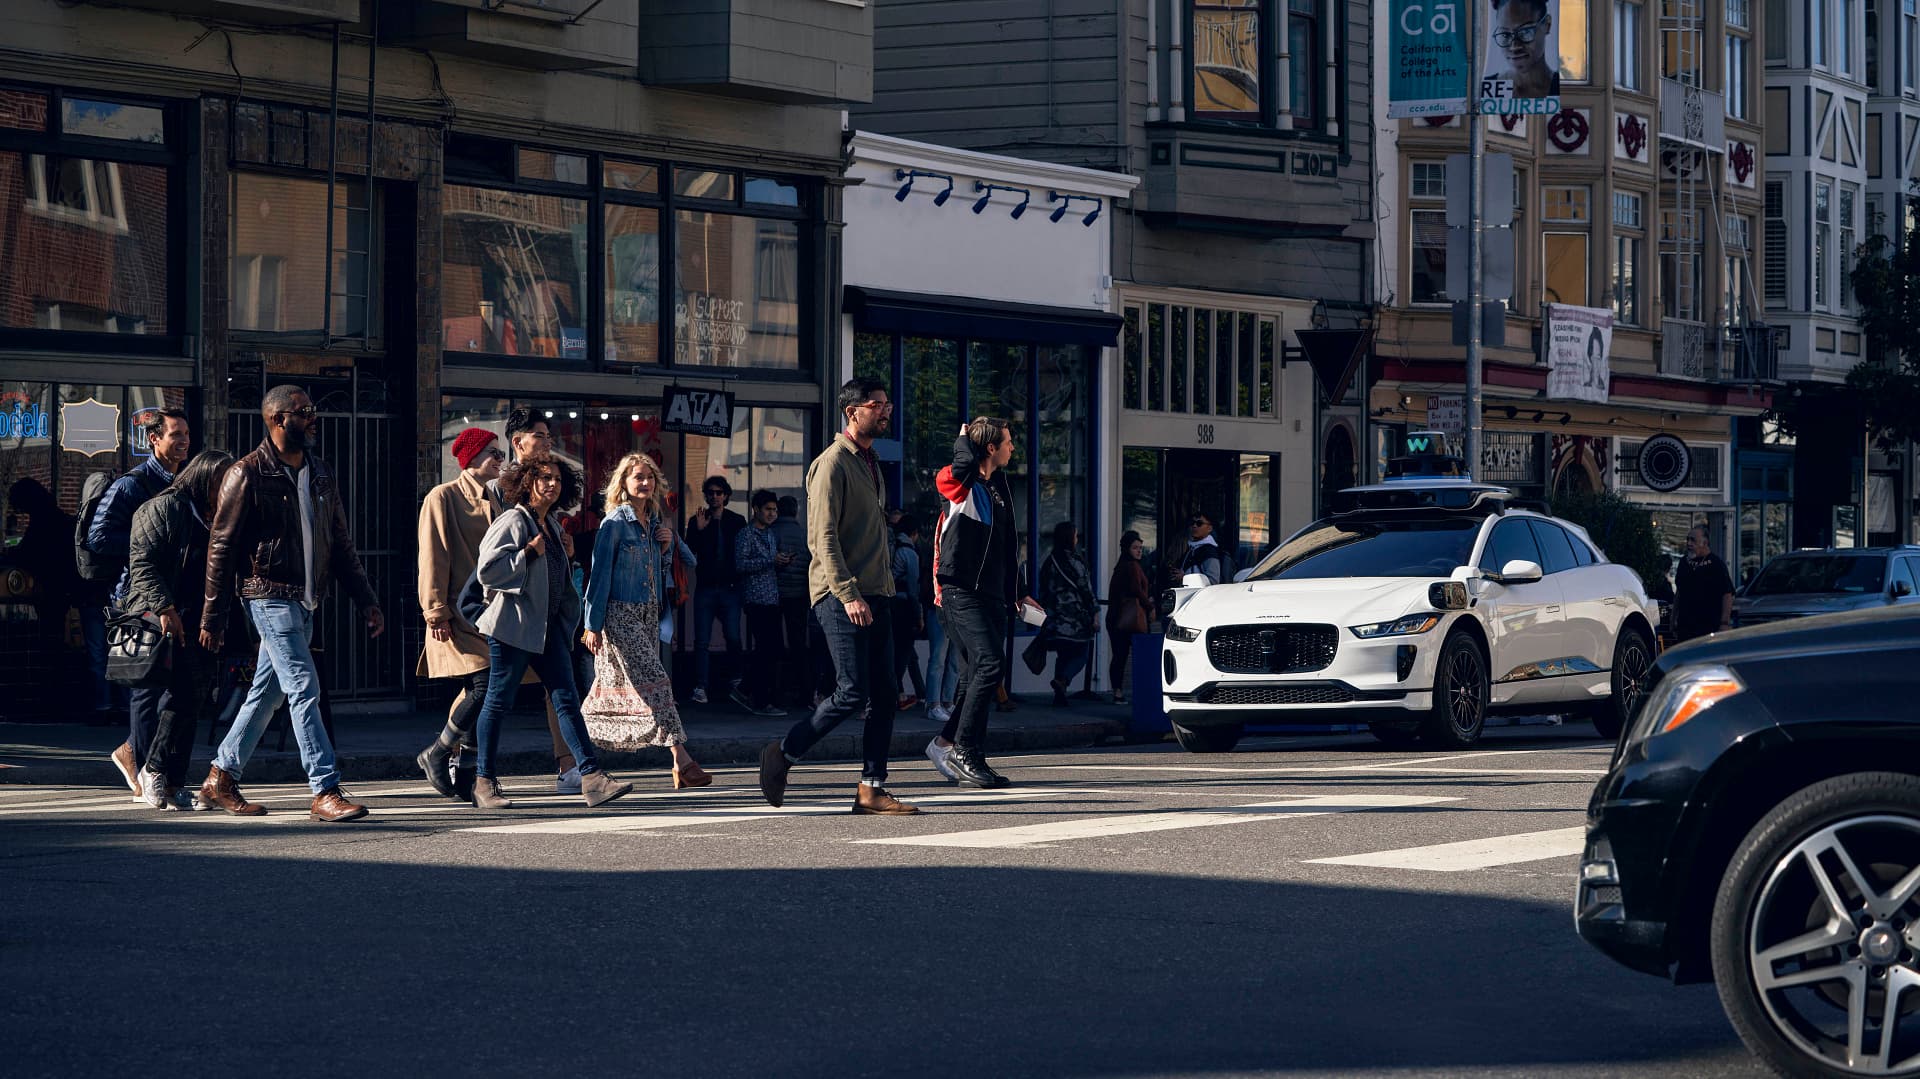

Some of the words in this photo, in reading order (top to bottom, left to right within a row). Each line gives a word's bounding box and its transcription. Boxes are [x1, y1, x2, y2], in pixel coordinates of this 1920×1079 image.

[1401, 45, 1452, 55] California
[1401, 57, 1438, 67] College
[1401, 69, 1411, 79] of
[1415, 68, 1431, 77] the
[1434, 68, 1456, 77] Arts
[1481, 81, 1513, 98] RE-
[1409, 104, 1446, 113] cca.edu
[1481, 98, 1559, 115] QUIRED
[695, 297, 744, 321] SUPPORT
[562, 336, 585, 349] Bernie
[666, 392, 729, 427] ATA
[1198, 423, 1214, 444] 988
